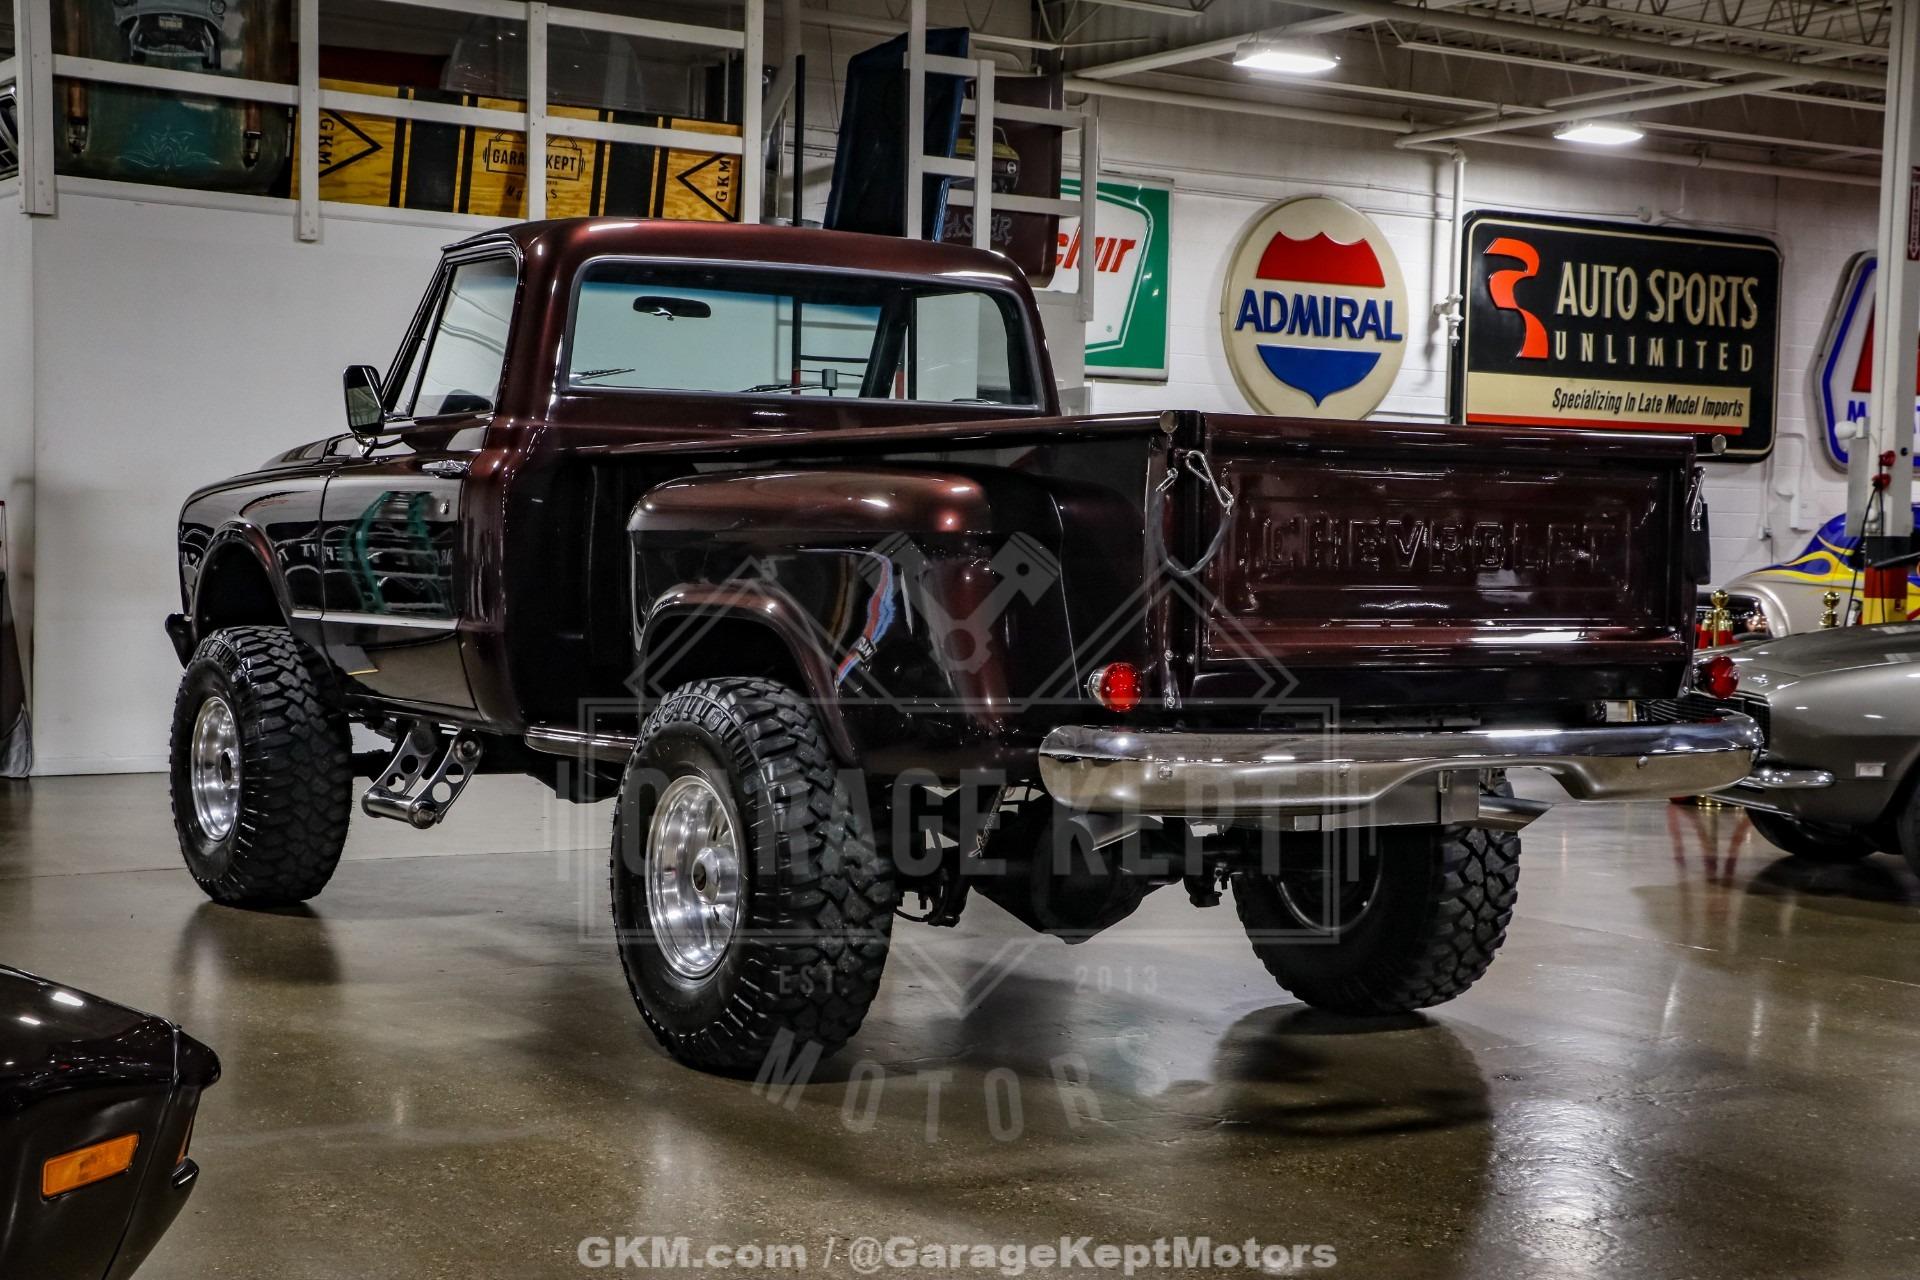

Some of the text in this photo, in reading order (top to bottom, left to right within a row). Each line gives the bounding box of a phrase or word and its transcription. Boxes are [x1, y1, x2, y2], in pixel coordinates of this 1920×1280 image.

[319, 118, 335, 165] GKM
[492, 148, 577, 172] GARA KEPT
[715, 160, 731, 203] GKM
[1234, 288, 1403, 342] ADMIRAL
[1555, 261, 1759, 330] AUTO SPORTS
[1555, 330, 1754, 373] UNLIMITED
[1552, 387, 1744, 419] Specializing In Late Model Imports
[1262, 518, 1616, 574] CHEVROLET
